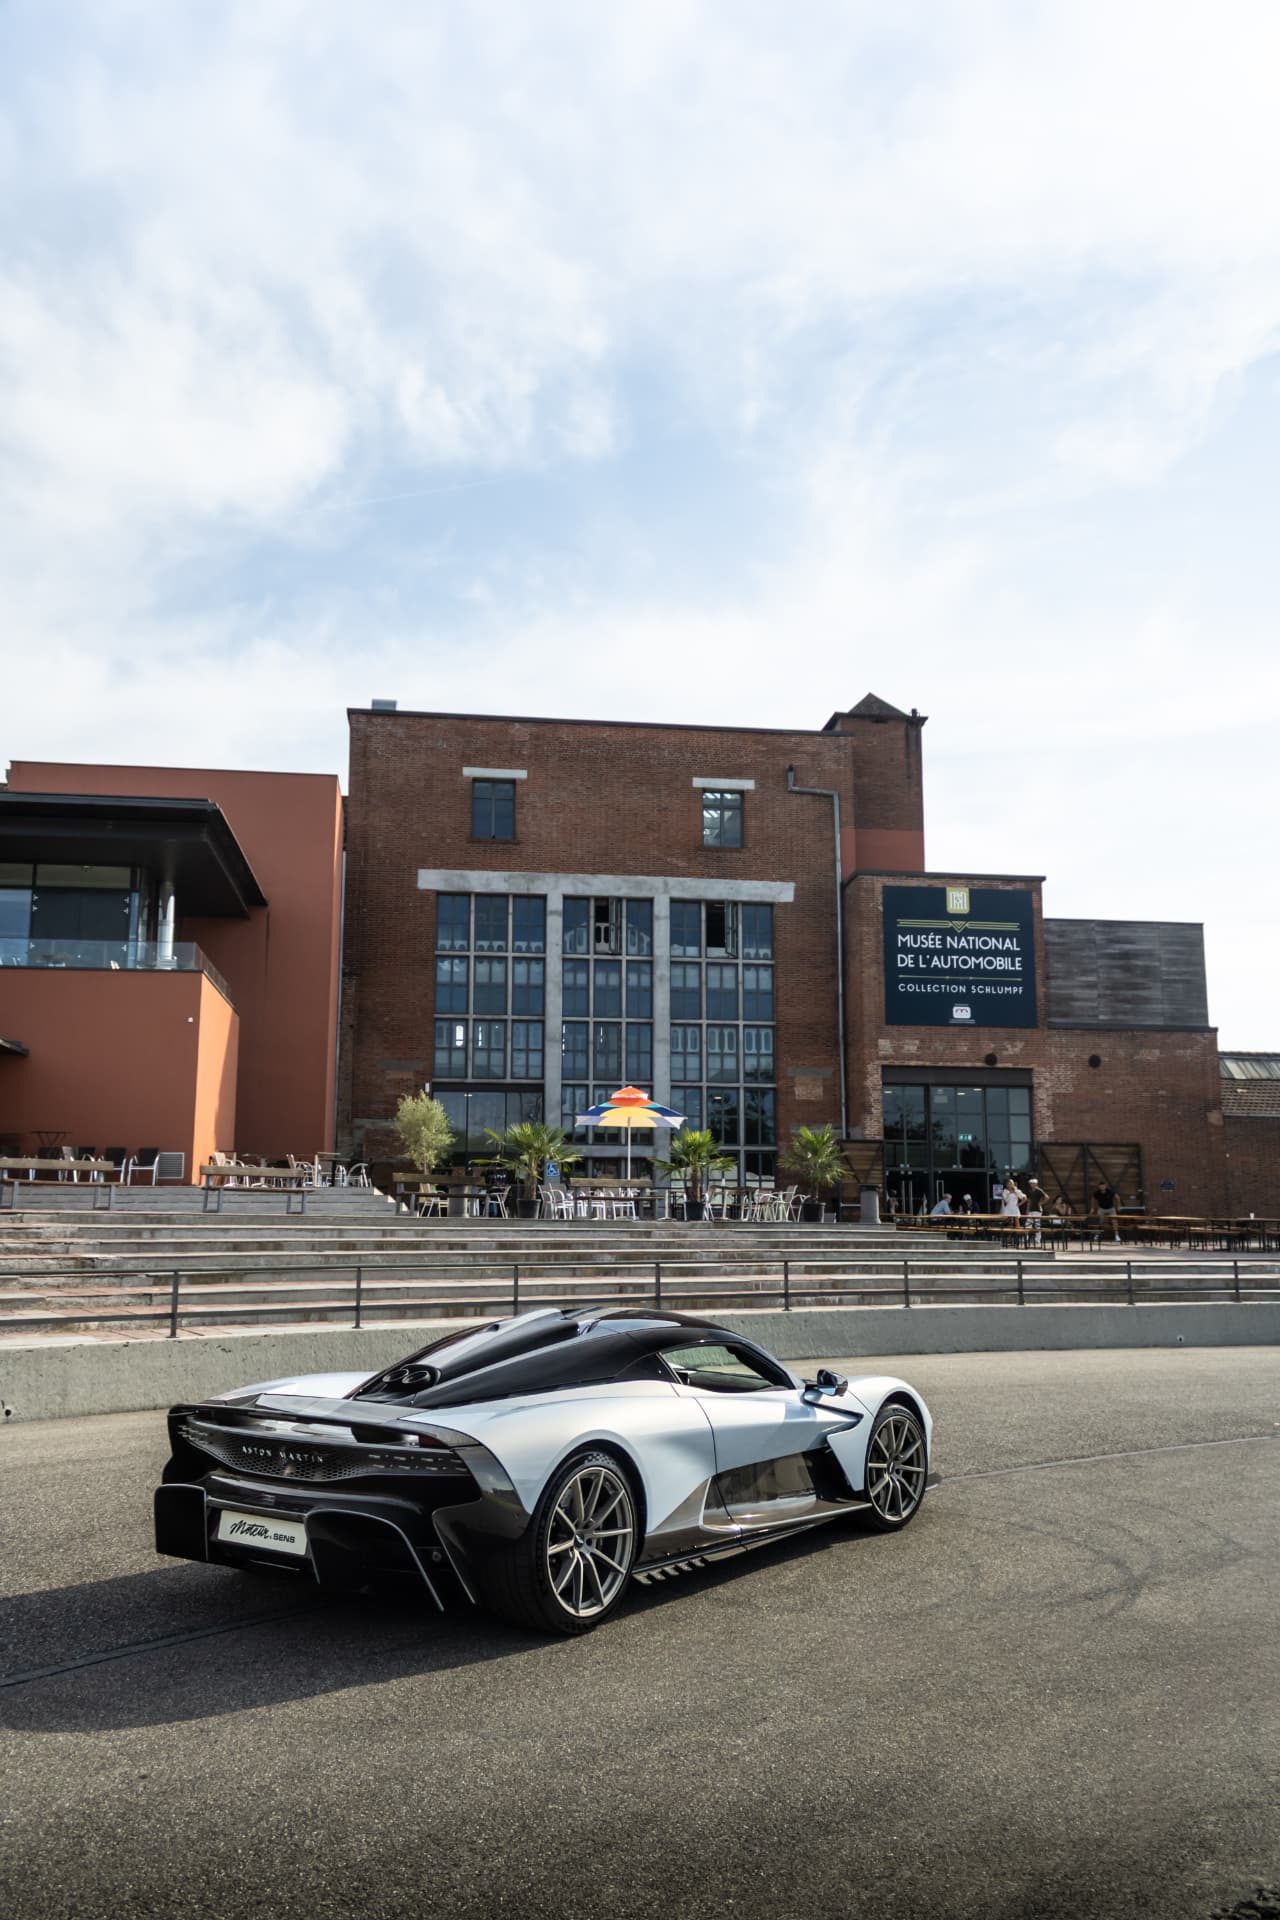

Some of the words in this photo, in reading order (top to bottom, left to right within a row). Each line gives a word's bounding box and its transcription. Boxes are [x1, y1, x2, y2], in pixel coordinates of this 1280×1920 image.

[897, 933, 943, 949] MUSÉE
[946, 936, 1021, 951] NATIONAL
[897, 954, 915, 968] DE
[919, 955, 1023, 970] L'AUTOMOBILE
[898, 983, 967, 993] COLLECTION
[971, 985, 1024, 995] SCHLUMPF
[242, 1446, 272, 1457] ASTON
[279, 1451, 324, 1463] MARTIN
